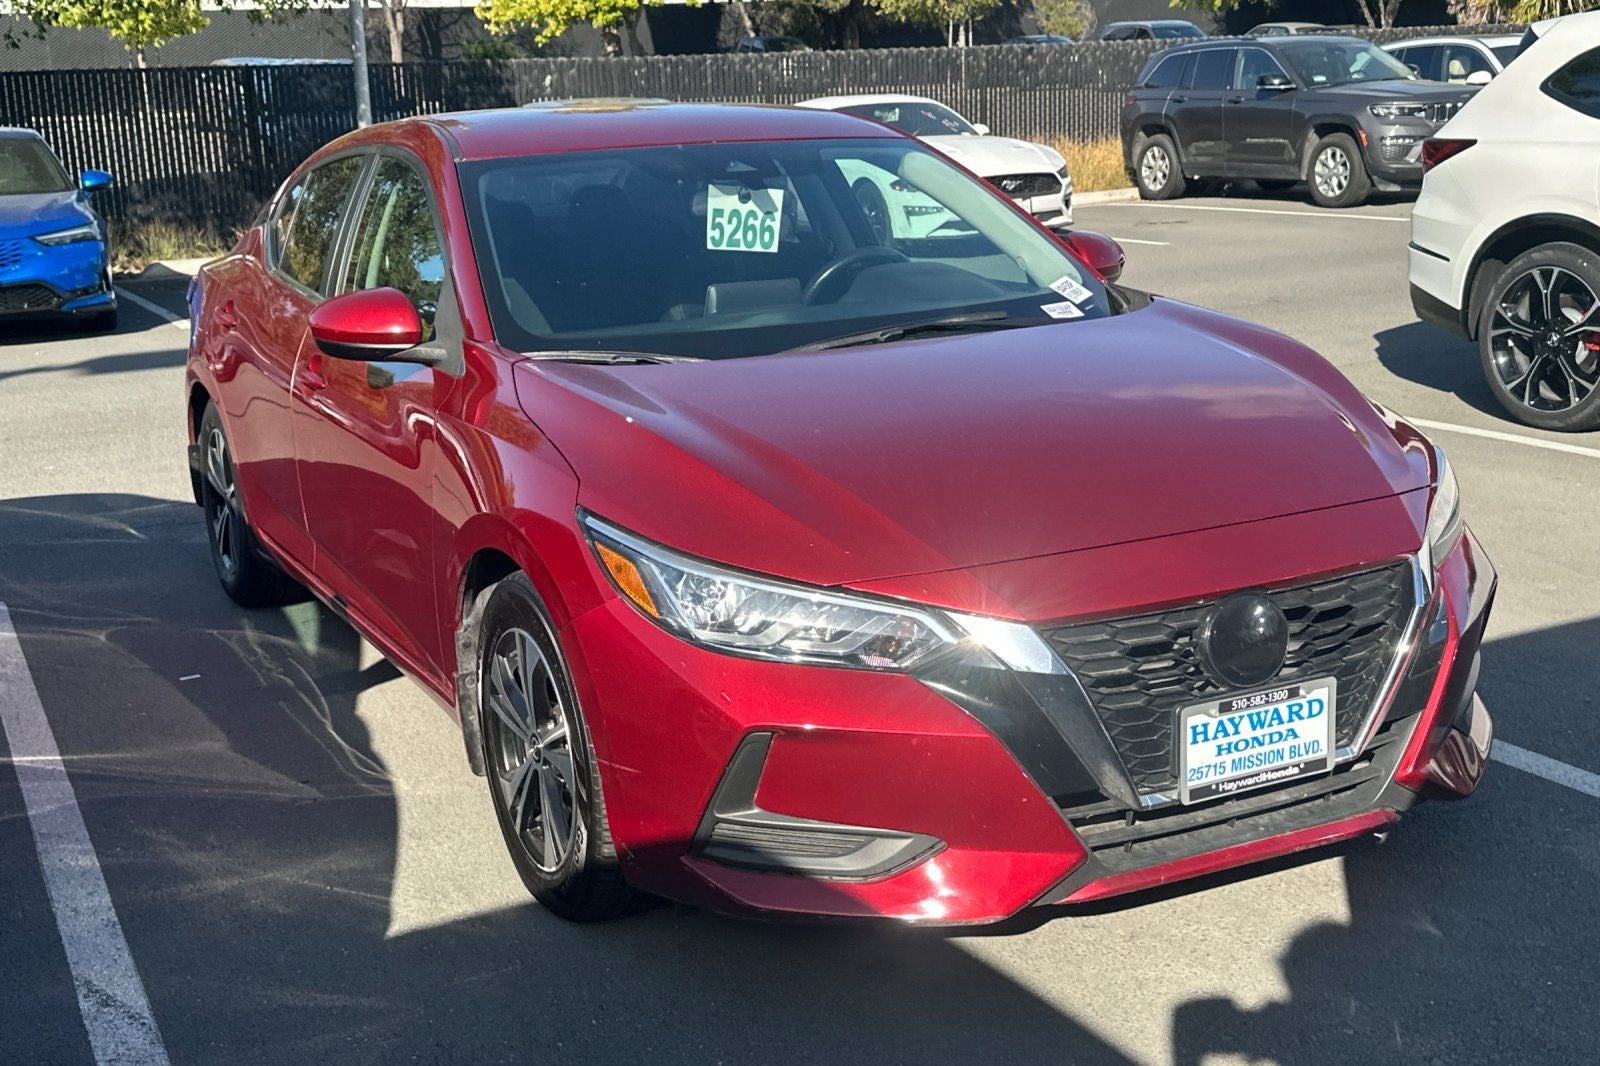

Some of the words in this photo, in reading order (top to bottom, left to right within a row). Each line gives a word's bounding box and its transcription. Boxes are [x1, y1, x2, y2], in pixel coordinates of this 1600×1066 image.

[710, 208, 776, 250] 5266
[1231, 690, 1289, 711] 510-582-1300
[1190, 698, 1324, 746] HAYWARD
[1215, 728, 1300, 757] HONDA
[1188, 761, 1226, 783] 25715
[1230, 747, 1285, 773] MISSION
[1289, 739, 1323, 760] BLVD.
